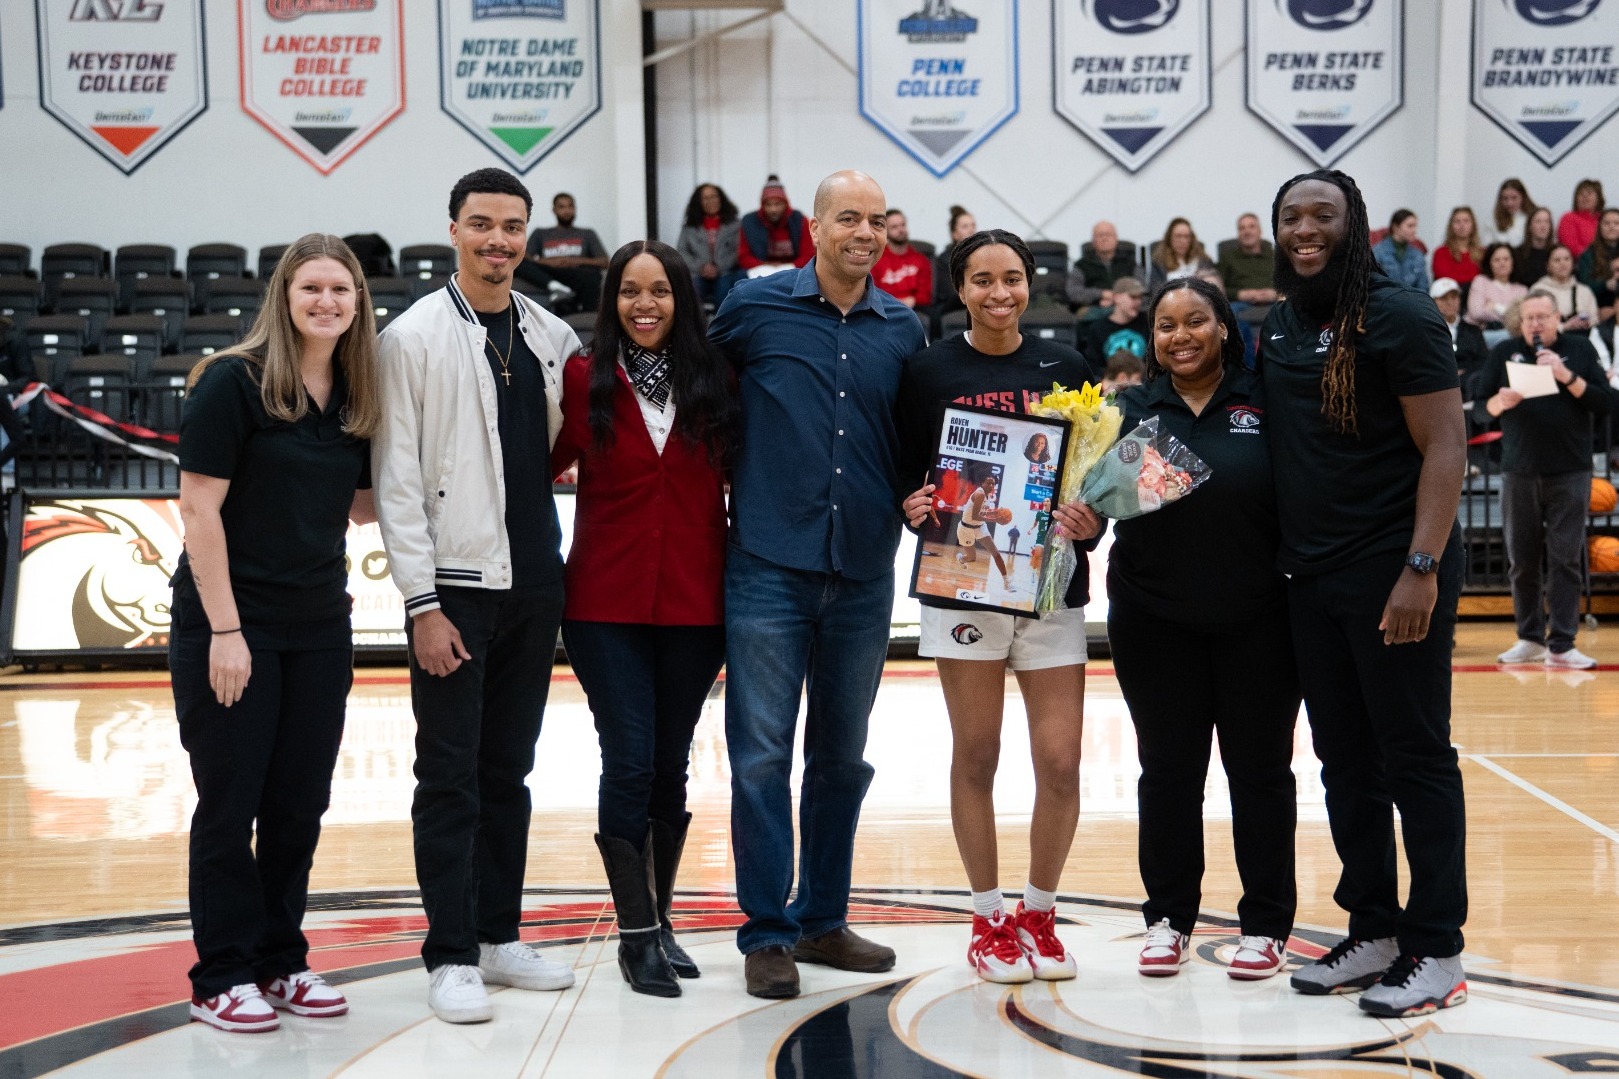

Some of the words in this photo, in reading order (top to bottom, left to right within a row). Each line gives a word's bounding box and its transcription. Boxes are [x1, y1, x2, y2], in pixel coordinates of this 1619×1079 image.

[262, 35, 381, 54] LANCASTER
[461, 38, 520, 57] NOTRE
[526, 38, 578, 57] DAME
[68, 53, 177, 71] KEYSTONE
[1071, 56, 1125, 74] PENN
[1131, 54, 1192, 73] STATE
[1264, 52, 1319, 70] PENN
[1324, 52, 1385, 70] STATE
[1490, 48, 1546, 66] PENN
[1551, 46, 1614, 65] STATE
[293, 57, 353, 75] BIBLE
[456, 60, 479, 78] OF
[485, 60, 584, 78] MARYLAND
[912, 58, 966, 75] PENN
[79, 75, 168, 92] COLLEGE
[1081, 76, 1182, 95] ABINGTON
[1291, 73, 1357, 91] BERKS
[1483, 68, 1619, 88] BRANDYWINE
[279, 79, 367, 97] COLLEGE
[466, 82, 575, 99] UNIVERSITY
[896, 80, 981, 97] COLLEGE
[950, 416, 970, 427] RAVEN
[947, 425, 1009, 454] HUNTER
